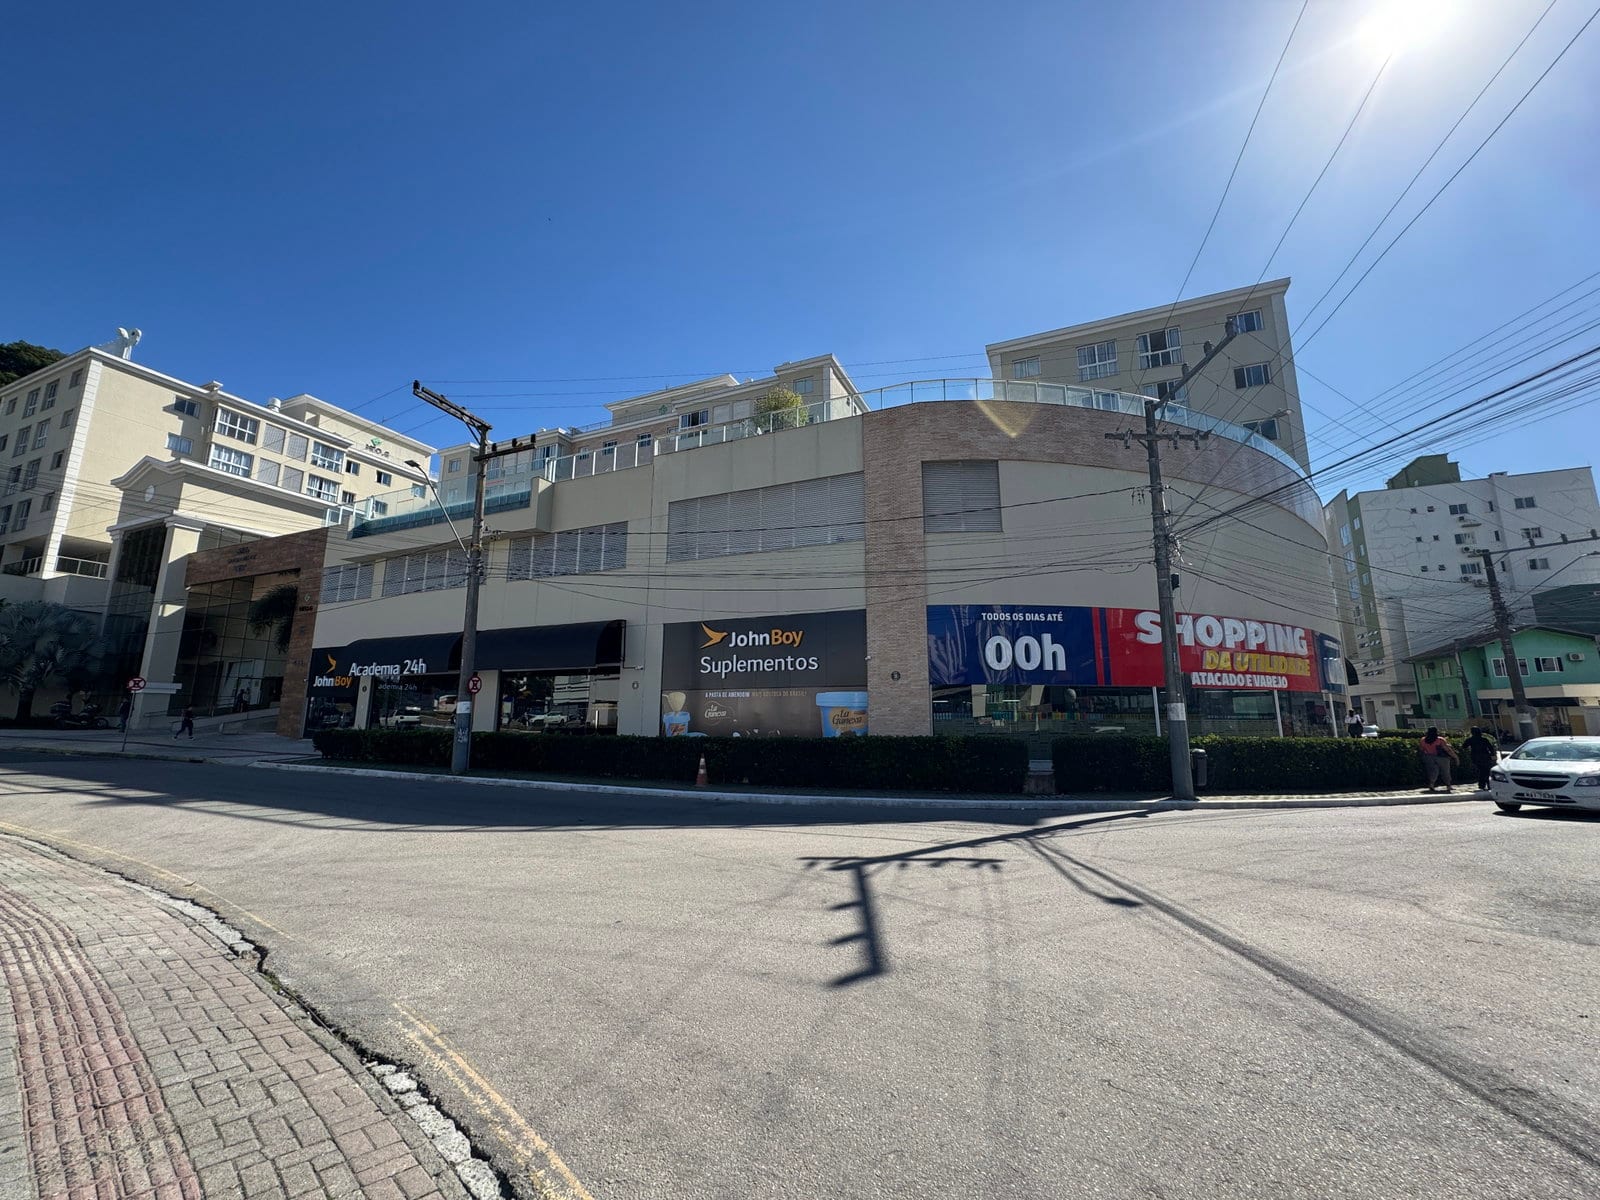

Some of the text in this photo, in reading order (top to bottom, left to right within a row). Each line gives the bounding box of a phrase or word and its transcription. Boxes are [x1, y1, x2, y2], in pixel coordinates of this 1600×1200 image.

[981, 611, 1064, 622] TODOS OS DIAS ATÉ
[729, 628, 804, 648] JohnBoy
[1135, 611, 1309, 656] SHOPPING
[985, 633, 1067, 671] 00h
[348, 658, 427, 676] Academia 24h
[700, 654, 819, 679] Suplementos
[1203, 650, 1233, 671] DA
[1233, 652, 1311, 677] UTILIDADE
[313, 675, 353, 688] JohnBoy
[1191, 671, 1288, 688] ATACADO E VAREJO
